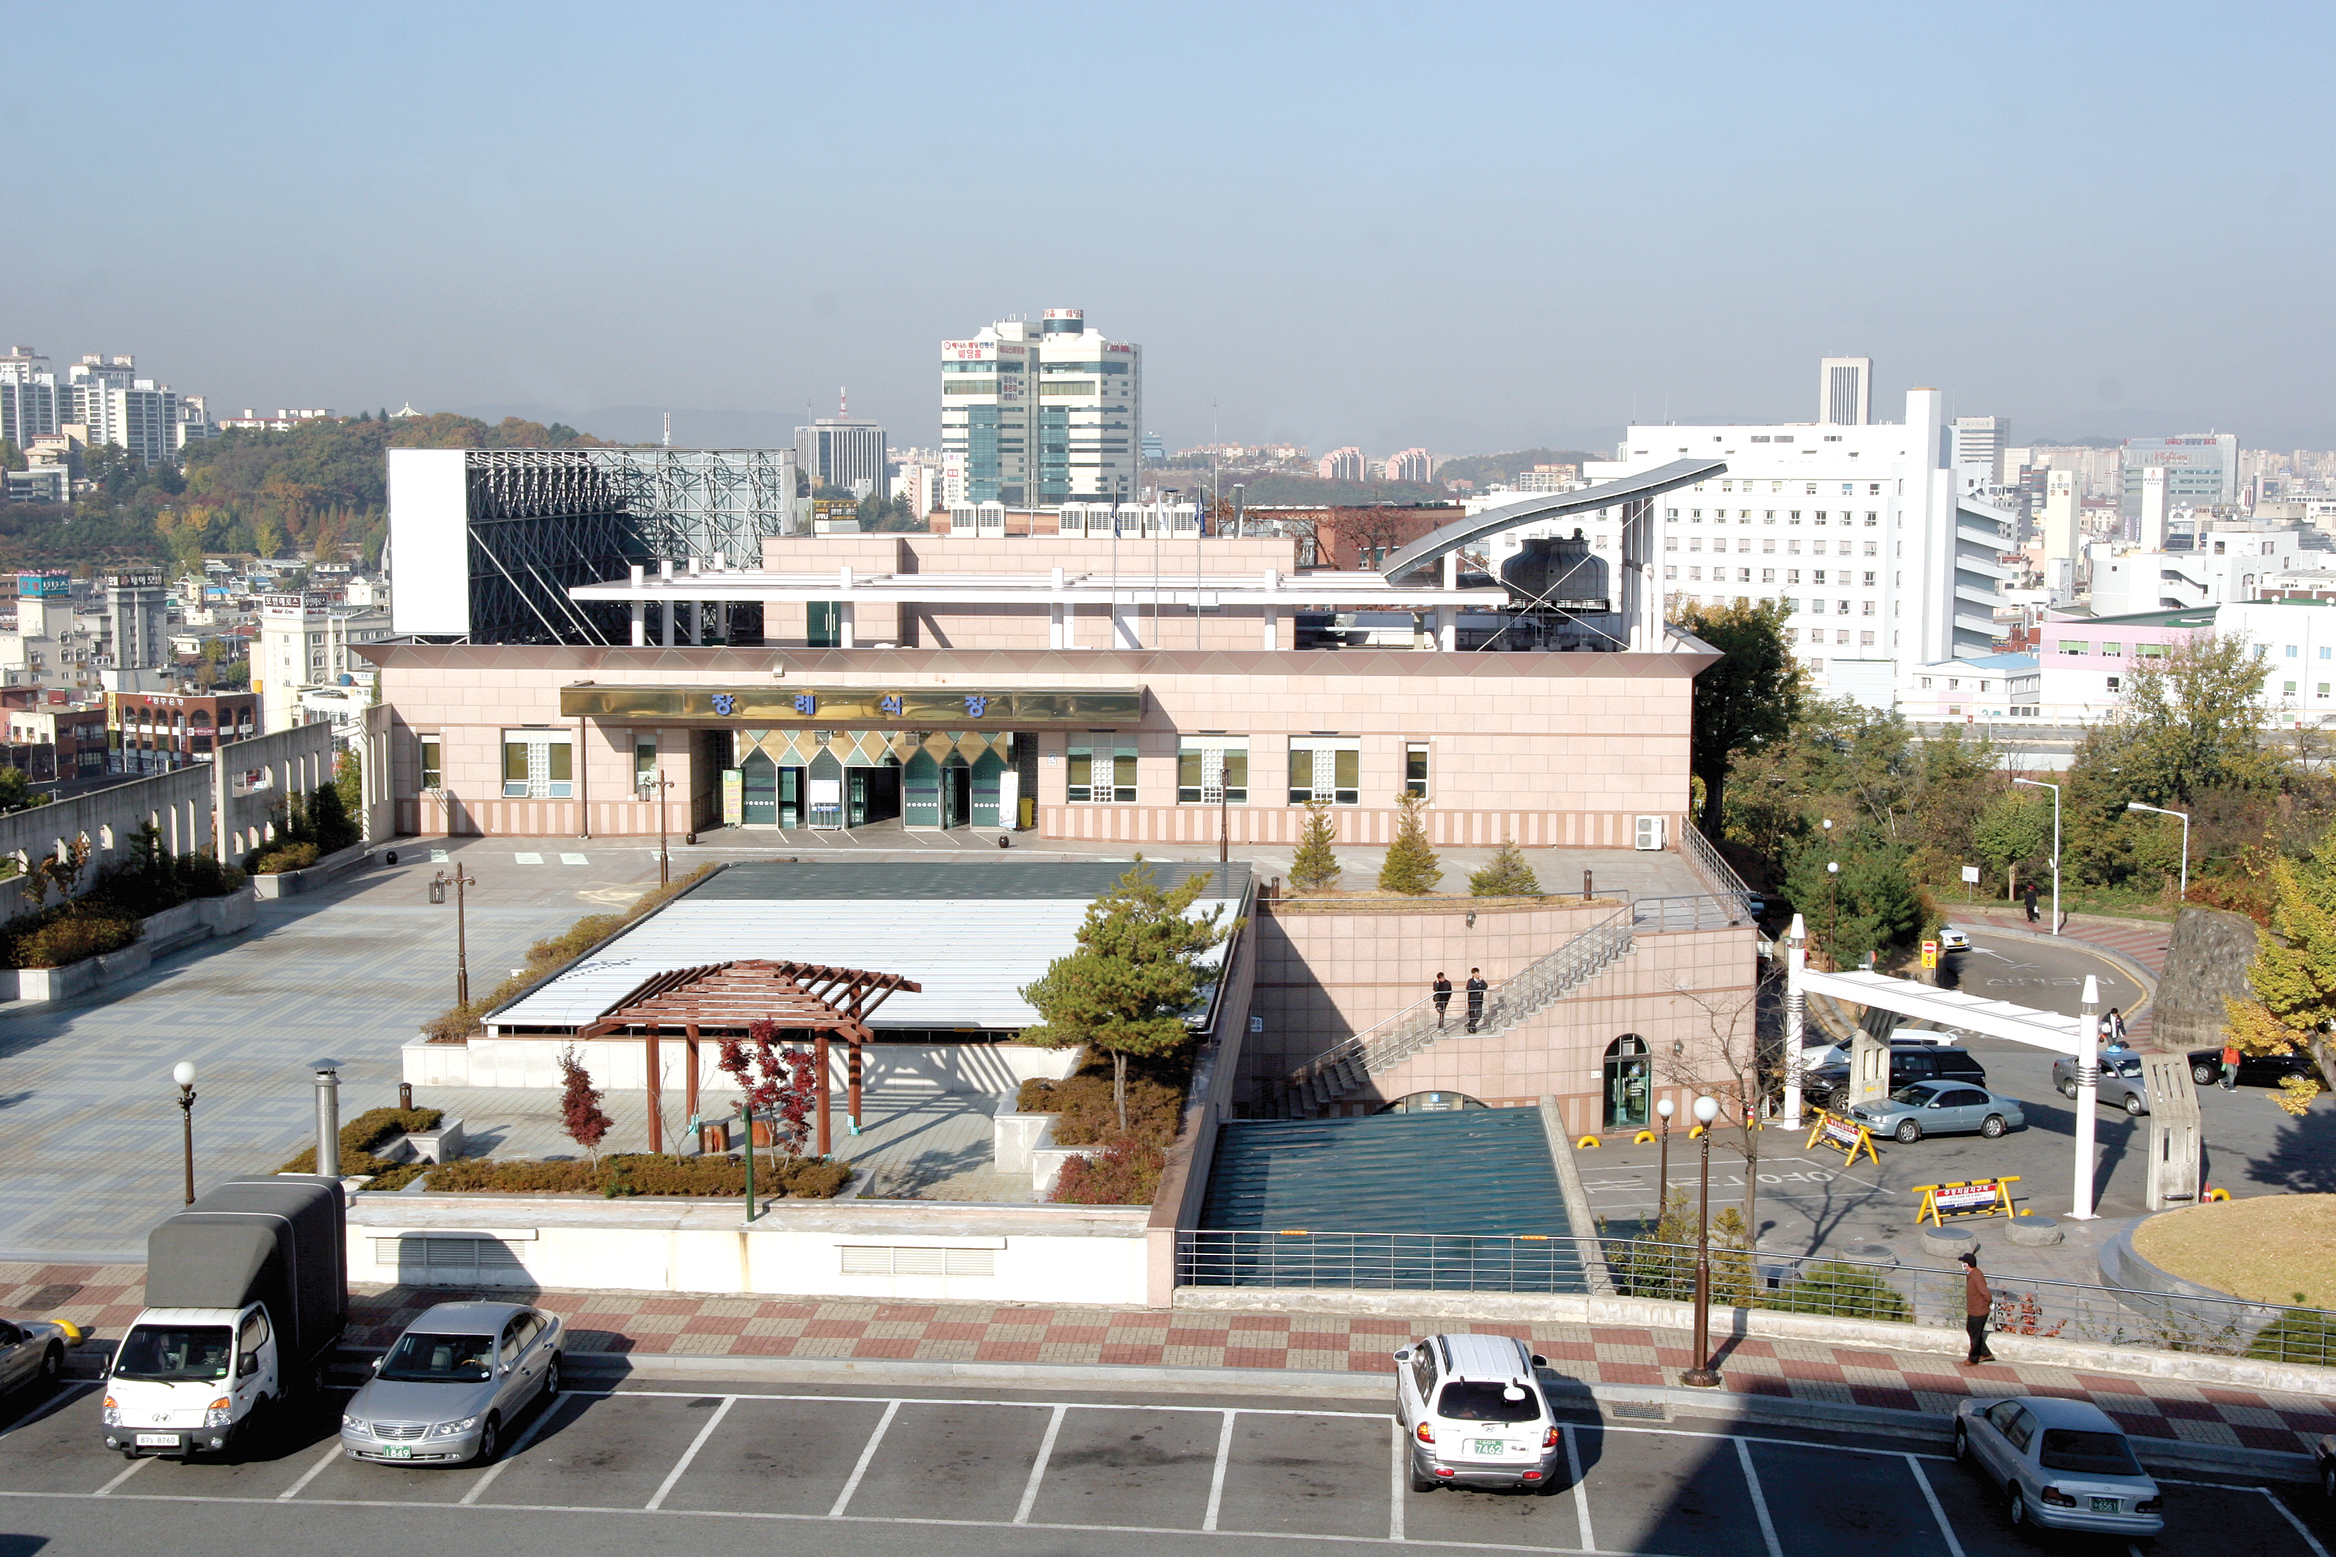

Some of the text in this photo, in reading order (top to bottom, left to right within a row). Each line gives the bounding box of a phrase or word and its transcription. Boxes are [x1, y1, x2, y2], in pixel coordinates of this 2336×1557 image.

[958, 349, 982, 359] 웨딩홀
[152, 697, 184, 706] 광주은행
[156, 1436, 176, 1445] 8260
[385, 1448, 411, 1458] 1849
[1476, 1444, 1502, 1454] 7462
[2098, 1501, 2117, 1511] 6561
